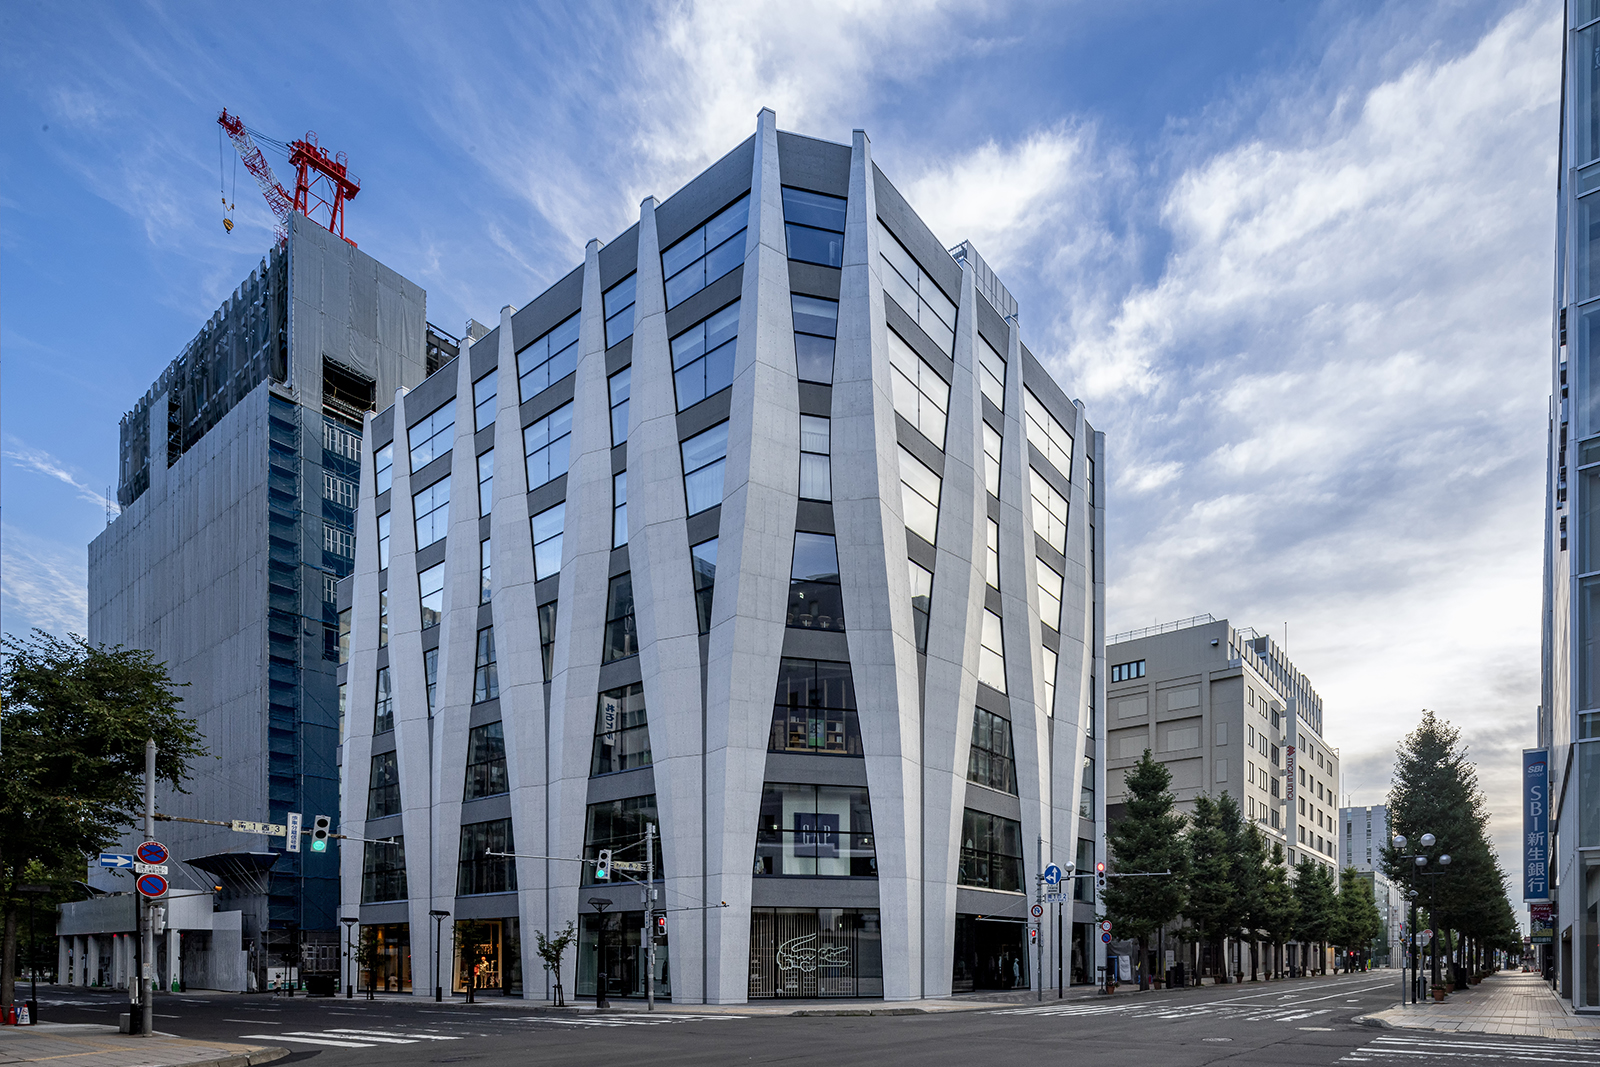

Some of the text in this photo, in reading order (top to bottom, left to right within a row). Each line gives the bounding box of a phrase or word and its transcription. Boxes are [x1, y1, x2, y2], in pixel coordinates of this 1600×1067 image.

[1528, 765, 1544, 774] SBI
[803, 824, 831, 845] GAP
[1527, 785, 1545, 892] SBI新生銀行
